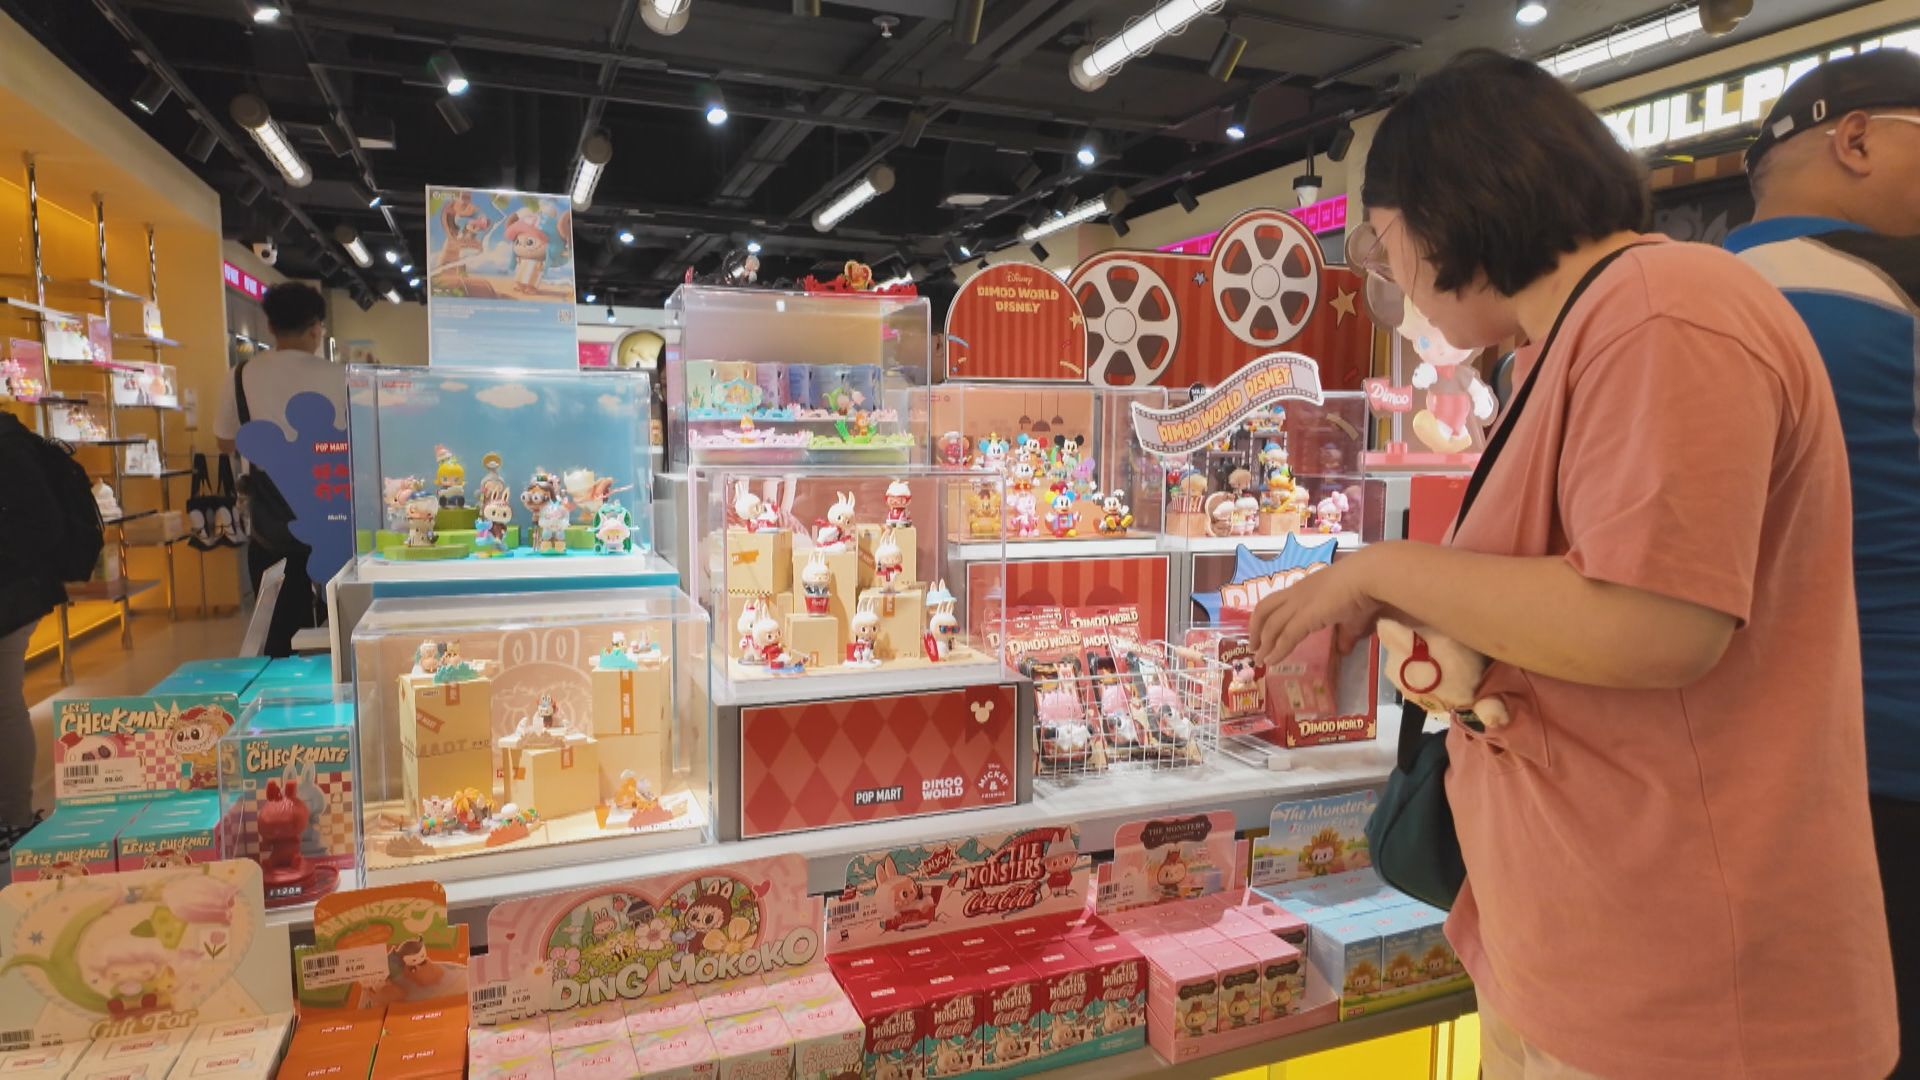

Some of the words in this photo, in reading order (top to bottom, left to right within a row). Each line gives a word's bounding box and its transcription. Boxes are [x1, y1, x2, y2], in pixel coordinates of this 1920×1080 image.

[1007, 271, 1033, 286] Disney
[1018, 287, 1060, 301] WORLD
[995, 301, 1041, 314] DISNEY
[1200, 389, 1243, 430] WORLD
[1243, 365, 1292, 400] DISNEY
[1370, 382, 1409, 406] Dimoo
[314, 442, 329, 453] POP
[329, 441, 348, 453] MART
[1109, 610, 1138, 624] WORLD
[1050, 633, 1081, 648] WORLD
[60, 706, 178, 737] CHECKMATE
[1336, 718, 1364, 733] WORLD
[246, 744, 350, 773] CHECKMATE
[922, 776, 964, 790] DIMOO
[978, 770, 1010, 788] MICKEY
[989, 780, 999, 791] &
[855, 791, 875, 805] POP
[876, 787, 902, 802] MART
[922, 787, 964, 800] WORLD
[981, 791, 1006, 799] FRIENDS
[1148, 826, 1163, 837] THE
[1165, 821, 1206, 834] MONSTERS
[1008, 841, 1041, 862] THE
[965, 858, 1042, 890] MONSTERS
[548, 962, 650, 1013] DING
[656, 926, 819, 995] MOKOKO
[1102, 970, 1139, 988] MONSTERS
[1049, 981, 1088, 1000] MONSTERS
[992, 992, 1033, 1013] MONSTERS
[143, 1008, 198, 1032] For
[934, 1006, 976, 1025] MONSTERS
[872, 1019, 917, 1039] MONSTERS
